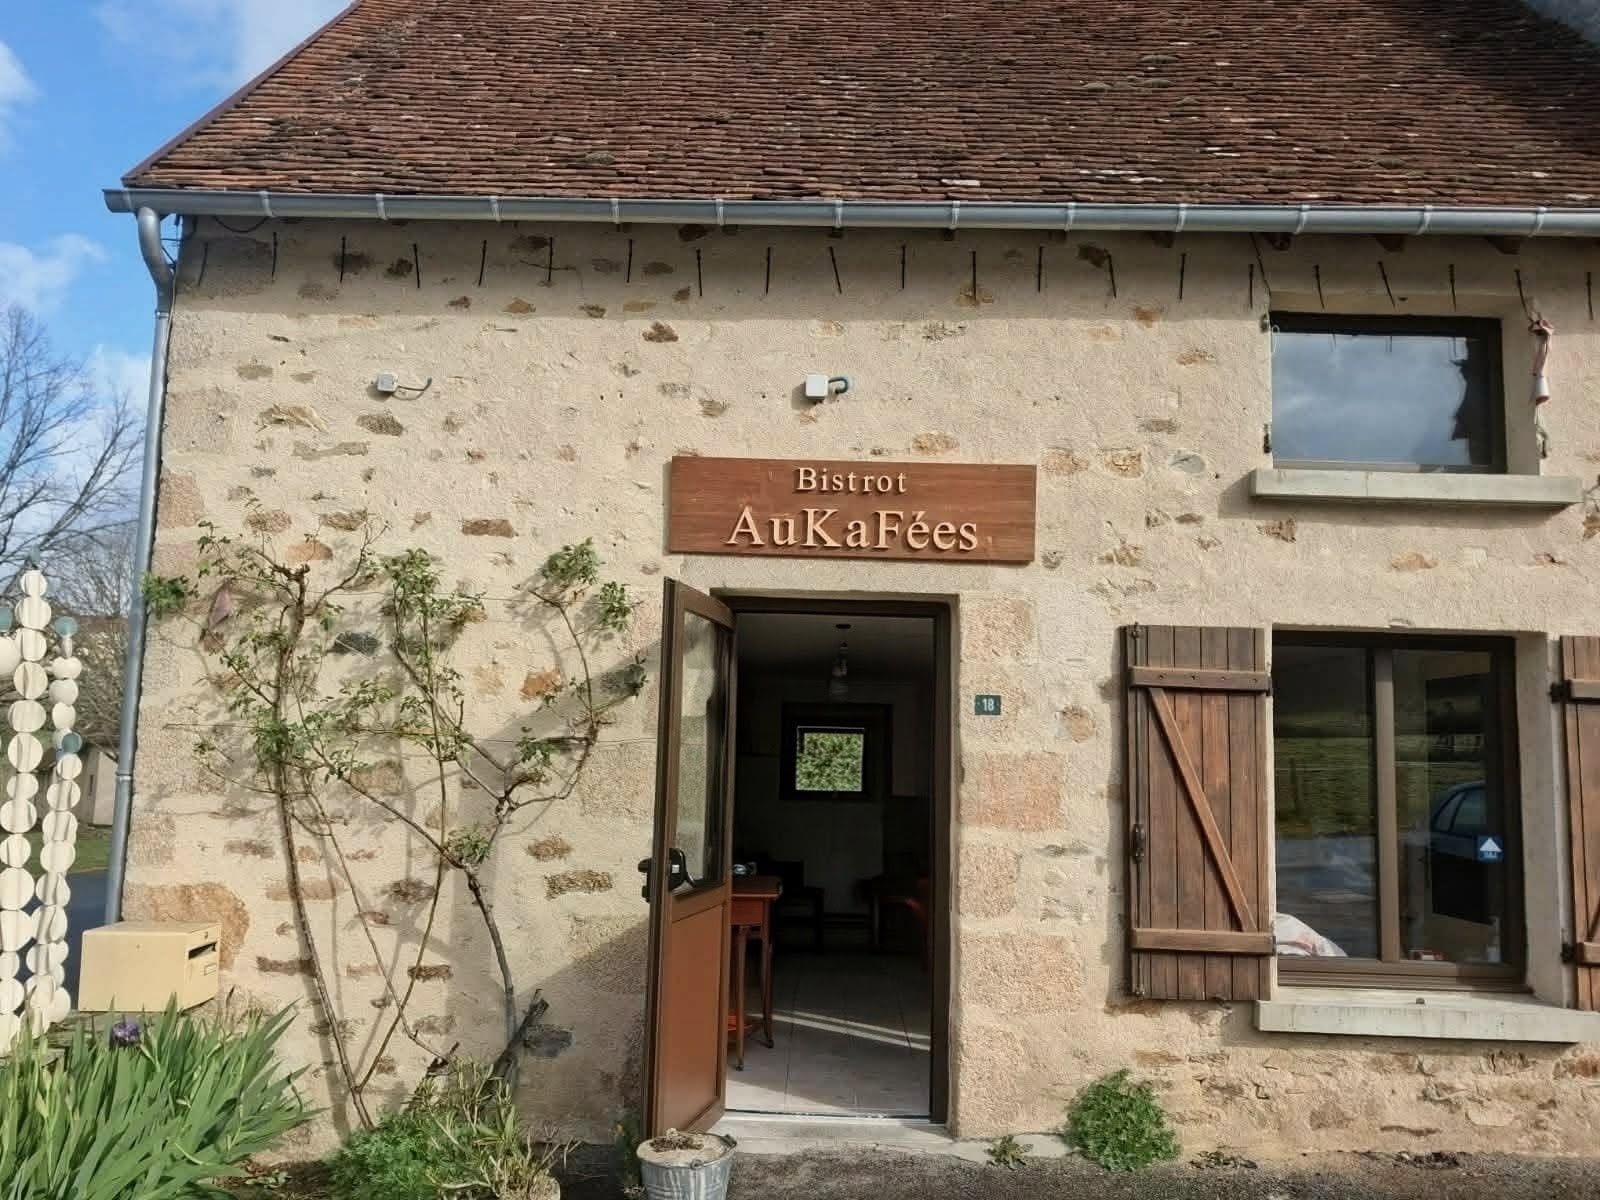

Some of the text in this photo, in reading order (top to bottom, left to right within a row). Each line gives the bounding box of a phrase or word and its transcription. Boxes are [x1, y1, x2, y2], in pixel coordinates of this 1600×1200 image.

[796, 467, 907, 493] Bistrot
[725, 505, 979, 551] AuKaFées
[981, 698, 995, 712] 18
